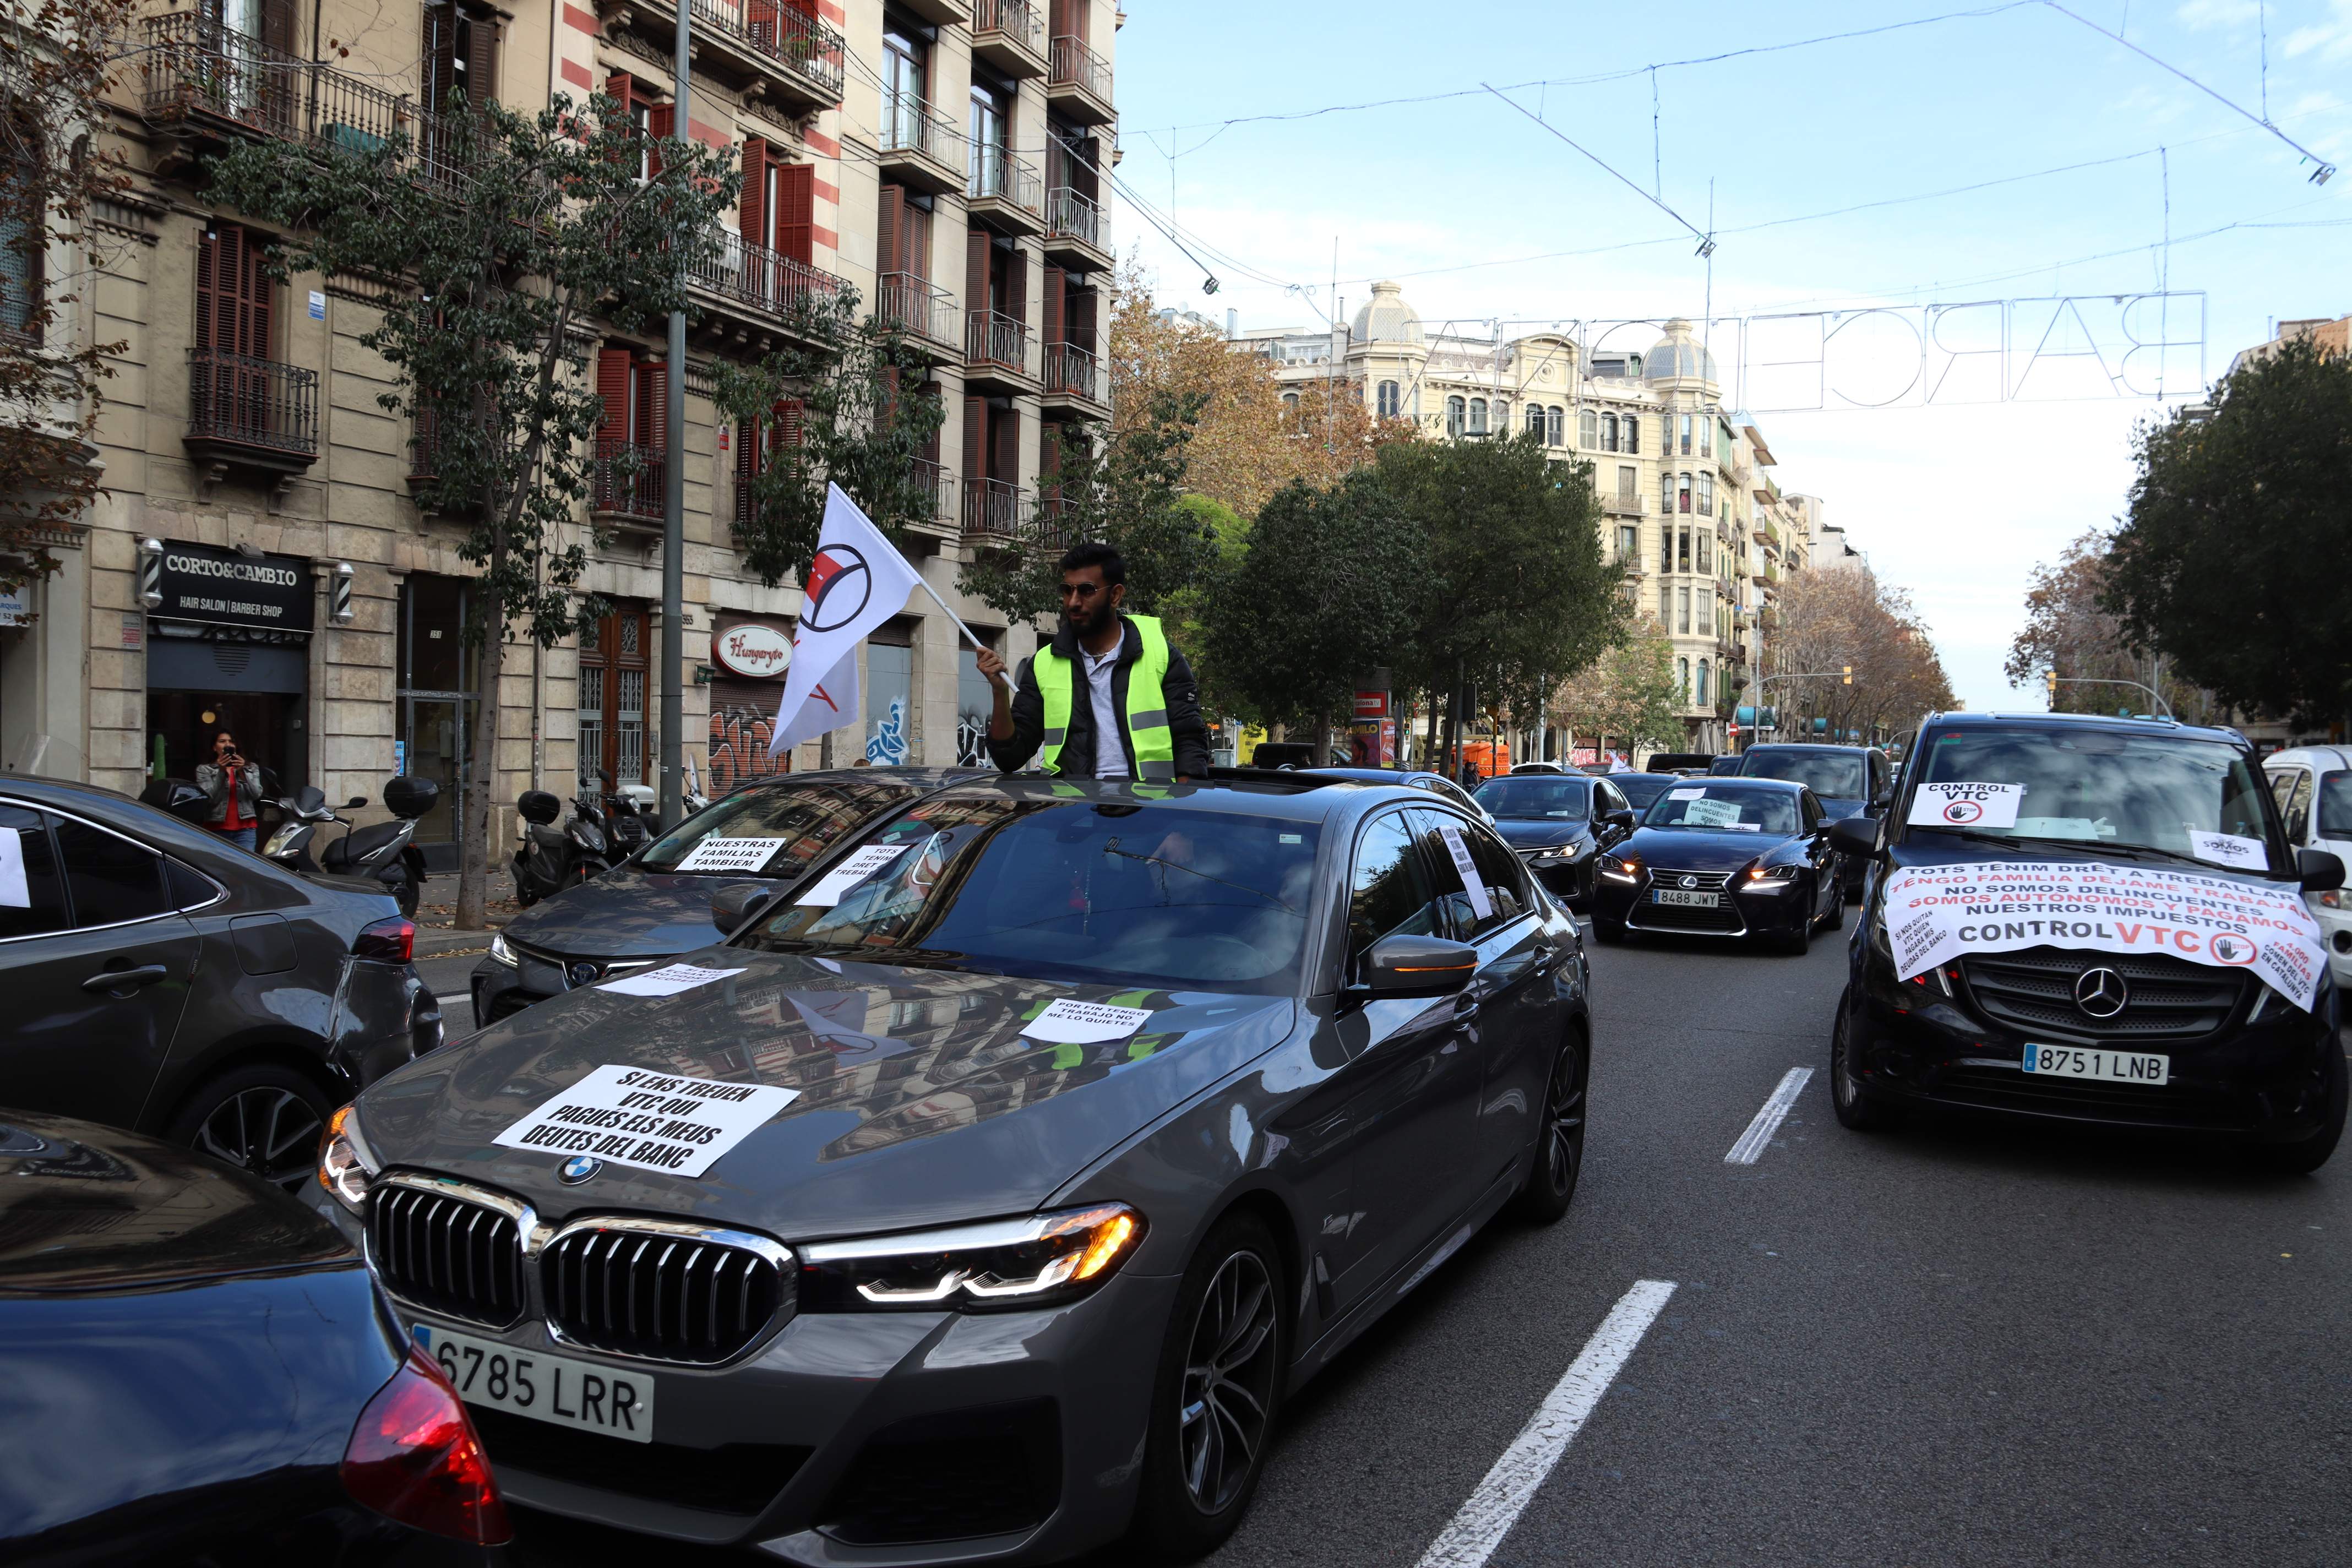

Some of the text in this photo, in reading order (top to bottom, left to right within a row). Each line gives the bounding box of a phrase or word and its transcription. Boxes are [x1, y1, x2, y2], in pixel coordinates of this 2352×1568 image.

[166, 554, 297, 586] CORTO&CAMBIO
[180, 596, 282, 617] HAIR SALON BARBER SHOP
[1929, 784, 2010, 793] CONTROL
[1945, 791, 1990, 801] VTC
[1691, 806, 1736, 820] DELINCUENTES
[1701, 815, 1722, 825] SOMOS
[1709, 802, 1730, 811] SOMOS
[1890, 876, 1968, 893] TENGO
[2082, 876, 2180, 891] DEJAME
[2058, 865, 2119, 874] DRET
[2152, 873, 2296, 901] TREBALLAR
[1662, 892, 1716, 905] 8488 JWY
[1908, 895, 1991, 908] SOMOS
[1999, 892, 2155, 908] AUTÓNOMOS
[2187, 906, 2304, 935] PAGAMOS
[2078, 886, 2264, 916] DELINCUENTES
[1895, 910, 1932, 940] SI NOS QUITAN
[1903, 921, 1930, 945] VTC QUIEN
[1924, 928, 1934, 939] MIS
[1967, 903, 2247, 934] NUESTROS IMPUESTOS
[1901, 930, 1946, 973] DEUDAS DEL BANCO
[2273, 941, 2311, 980] FAMILIAS
[2261, 952, 2302, 1000] EN CATALUNYA
[2264, 945, 2309, 993] COMEN DEL VTC
[1061, 1008, 1113, 1018] TRABAJO
[1086, 1017, 1135, 1026] QUIETES
[1107, 1008, 1145, 1016] TENGO
[2040, 1049, 2161, 1080] 8751 LNB
[616, 1071, 758, 1102] SI ENS TREUEN
[617, 1092, 704, 1116] VTC QUI
[546, 1105, 722, 1145] PAGUÉS ELS MEUS
[519, 1124, 694, 1168] DEUTES DEL BANC
[438, 1341, 636, 1431] 6785 LRR
